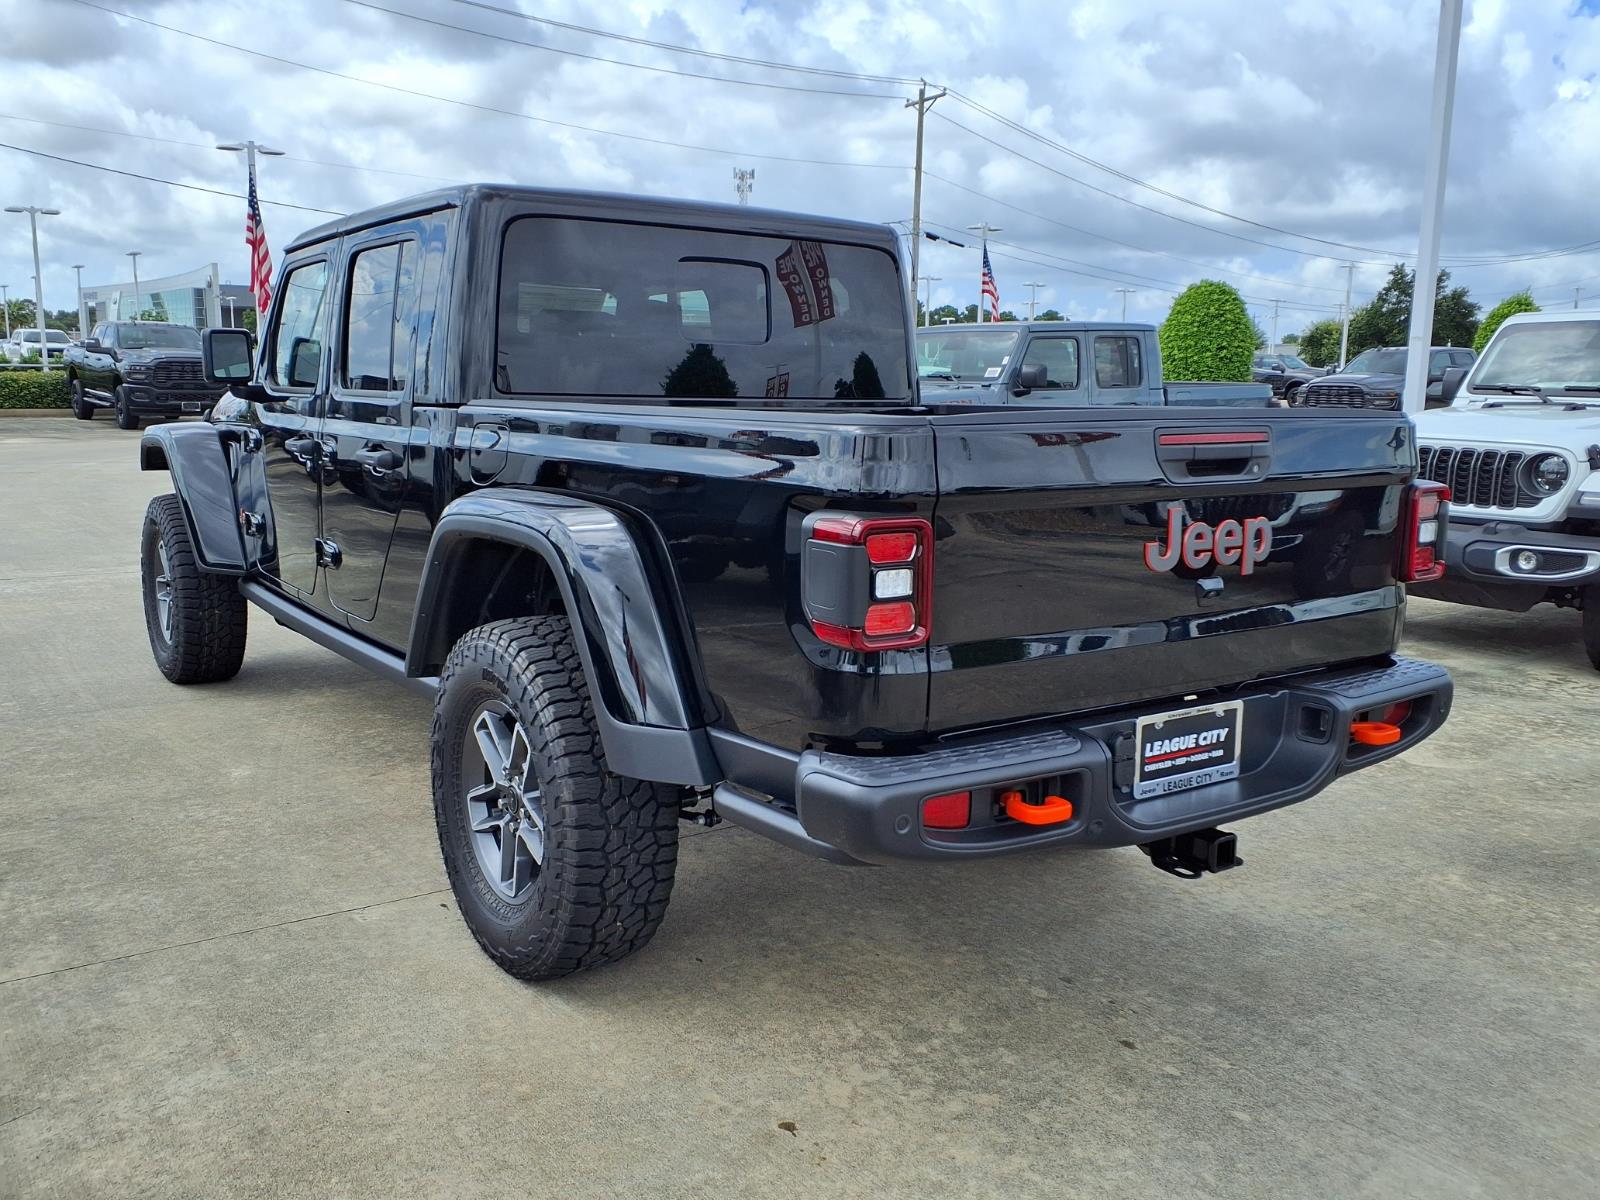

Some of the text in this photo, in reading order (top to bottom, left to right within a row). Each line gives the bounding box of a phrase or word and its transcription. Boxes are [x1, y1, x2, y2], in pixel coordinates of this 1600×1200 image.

[1144, 506, 1273, 576] Jeep
[1144, 728, 1229, 757] LEAGUE CITY
[1163, 777, 1194, 792] LEAGUE
[1196, 773, 1214, 785] CITY
